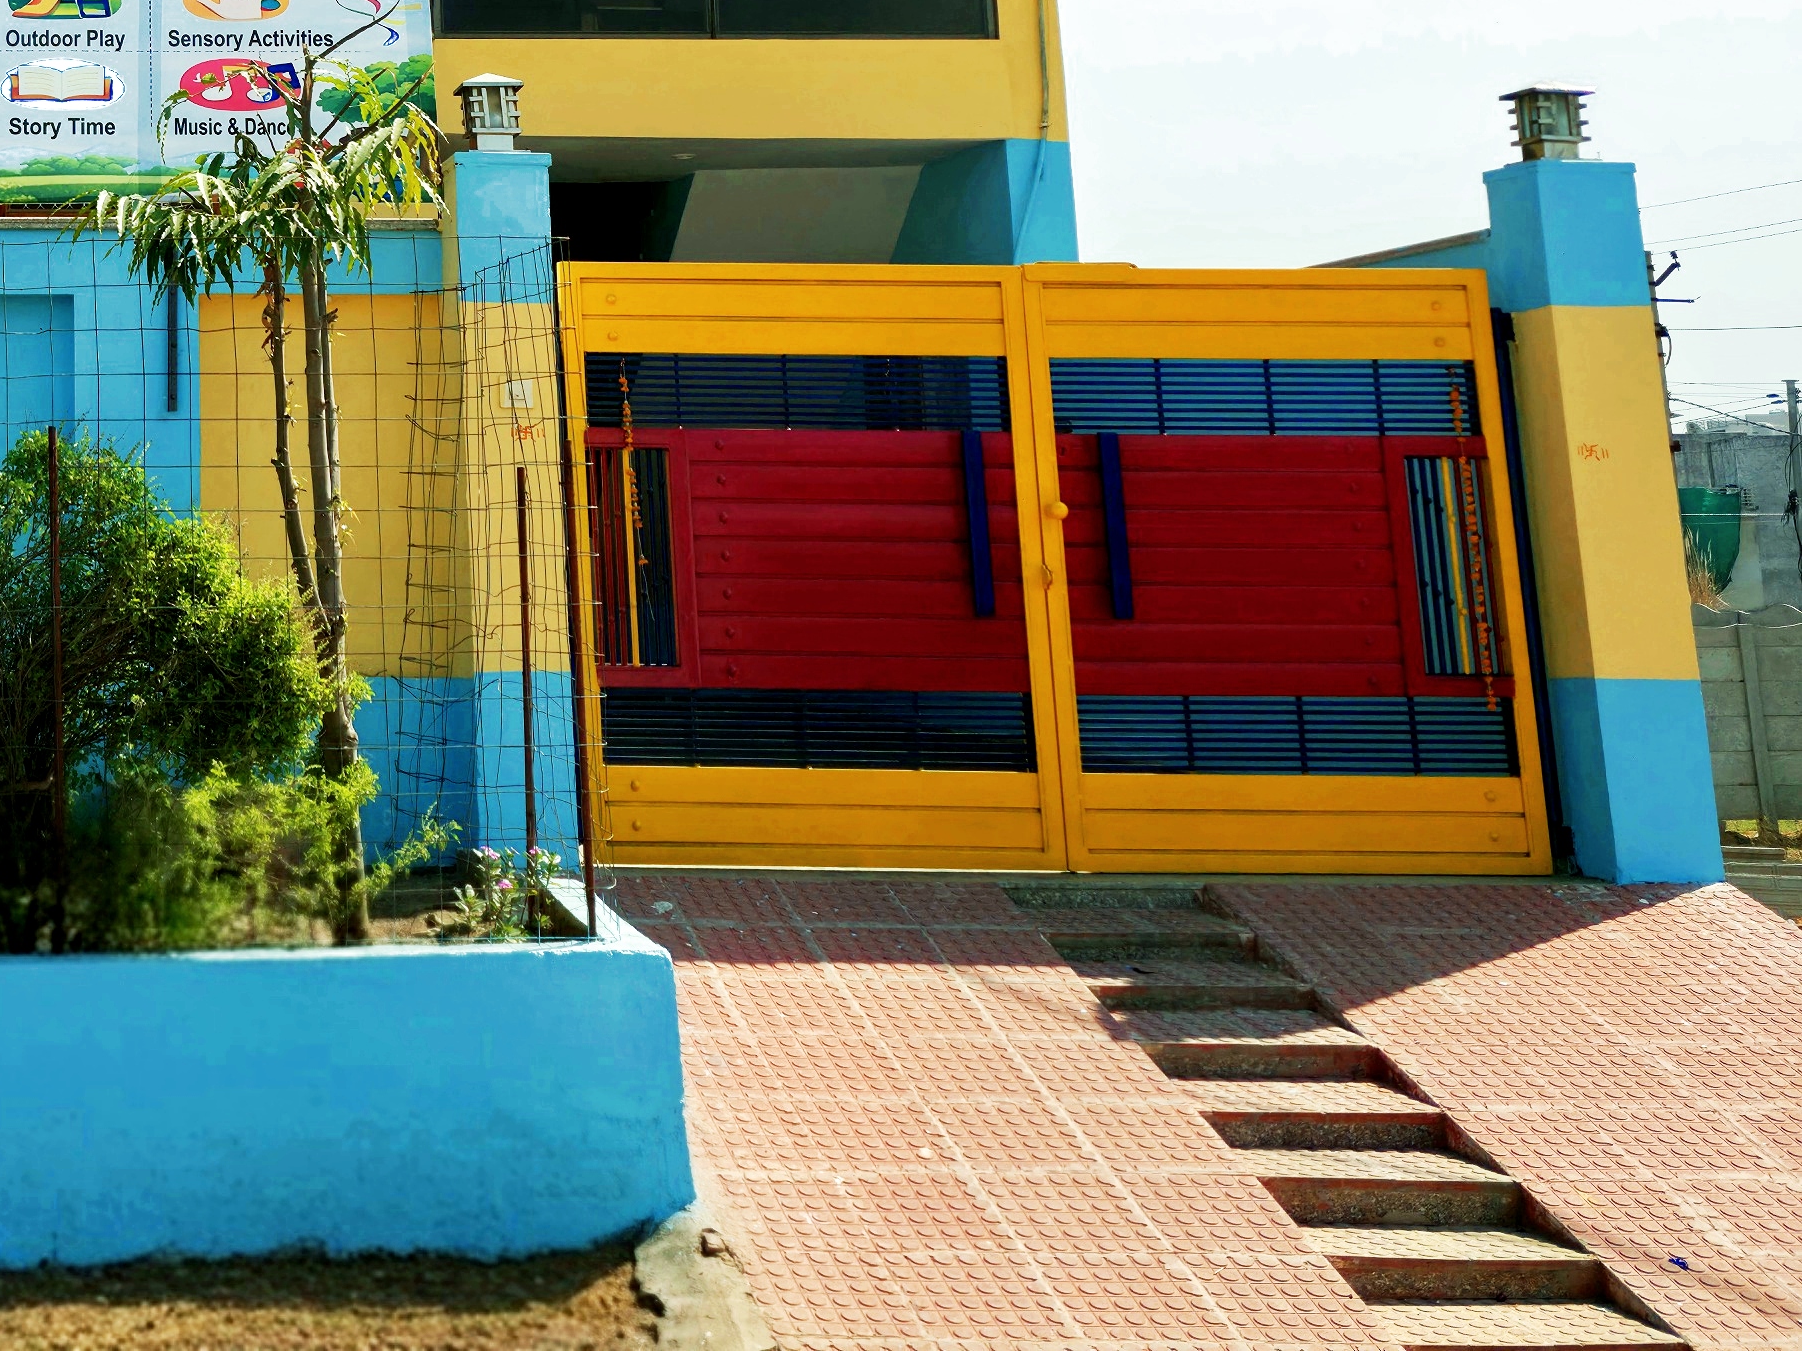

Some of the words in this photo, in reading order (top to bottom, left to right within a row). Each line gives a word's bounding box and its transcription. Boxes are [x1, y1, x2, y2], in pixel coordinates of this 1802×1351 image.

[6, 29, 81, 47] Outdoor
[87, 29, 126, 52] Play
[168, 30, 244, 51] Sensory
[248, 29, 334, 47] Activities
[9, 117, 62, 139] Story
[68, 117, 116, 135] Time
[174, 118, 223, 135] Music
[228, 118, 239, 136] &
[245, 118, 294, 135] Danc
